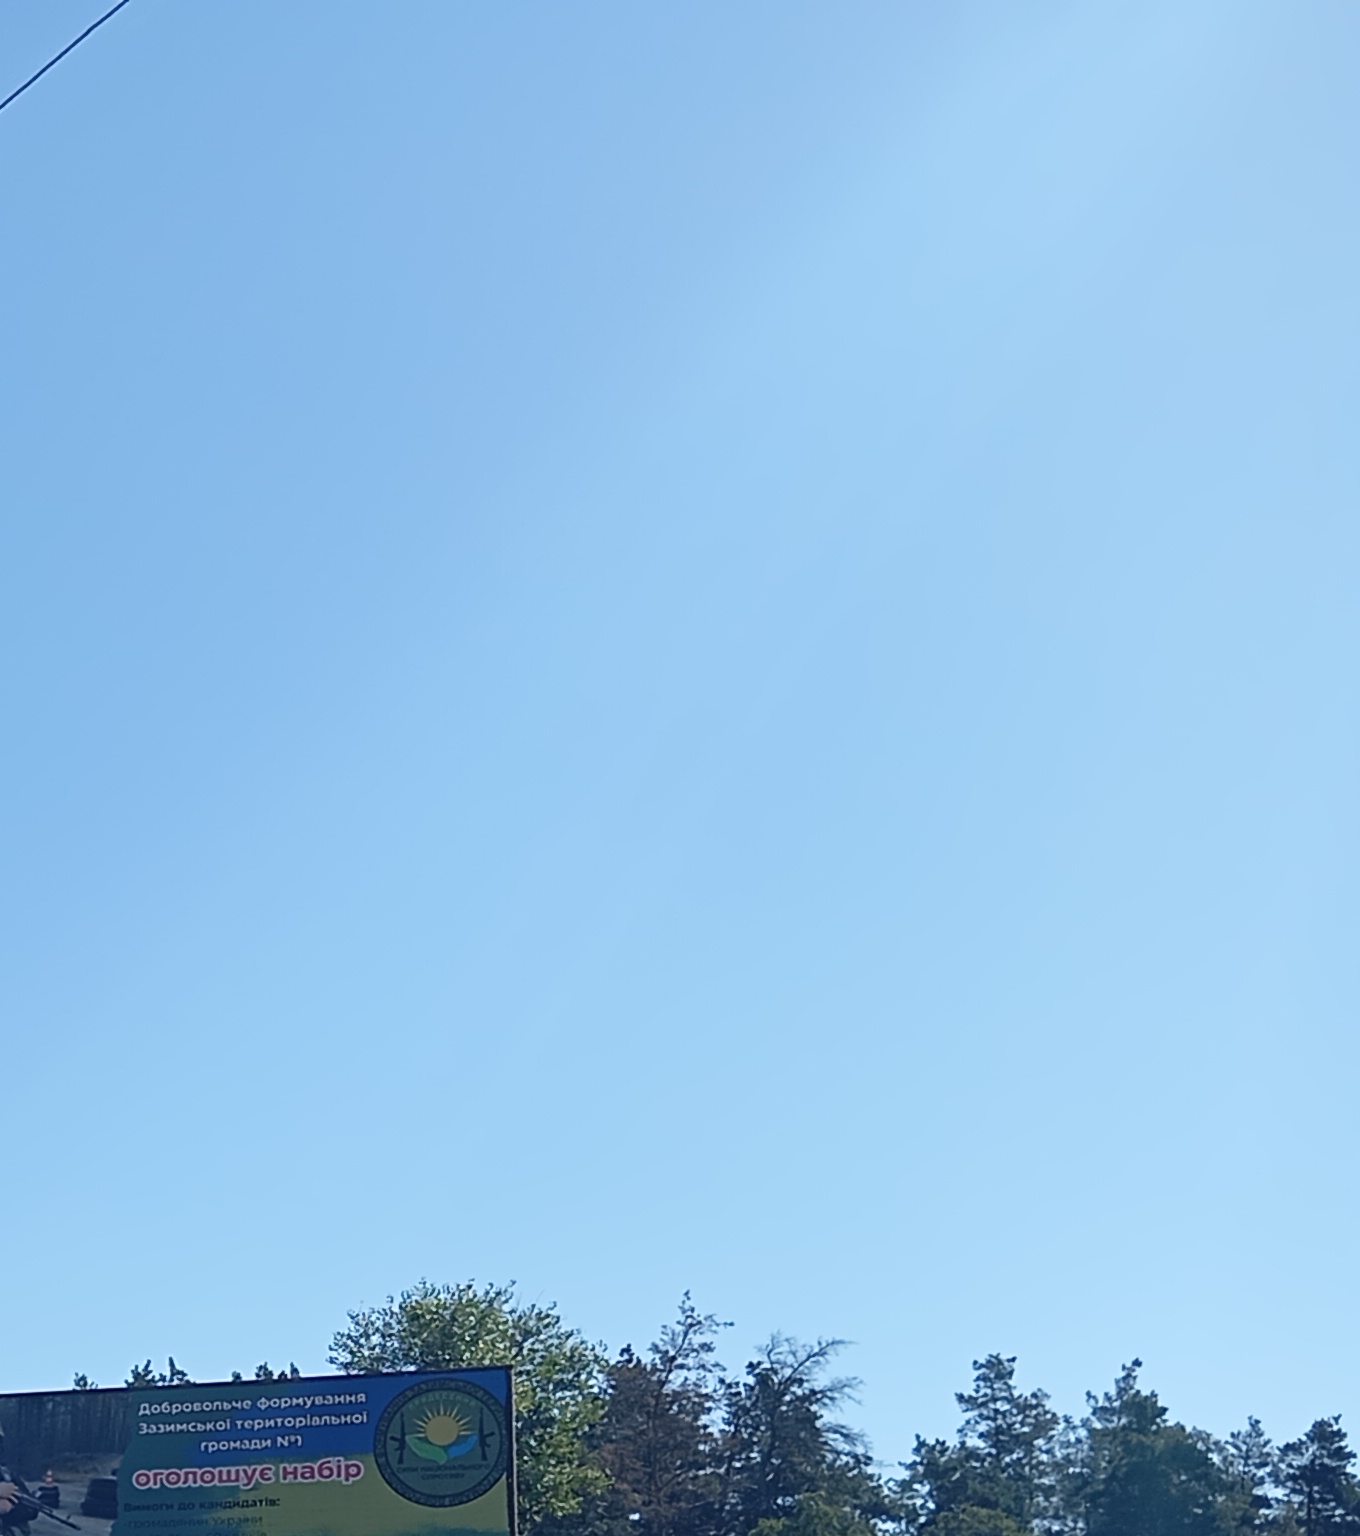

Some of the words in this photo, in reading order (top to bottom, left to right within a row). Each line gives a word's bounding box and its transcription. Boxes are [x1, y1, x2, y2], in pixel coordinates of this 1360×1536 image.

[138, 1399, 251, 1417] Добровольче
[256, 1392, 367, 1411] формування
[138, 1418, 231, 1435] Зазимської
[235, 1411, 368, 1432] територіальної
[200, 1438, 271, 1454] громади
[133, 1463, 275, 1489] оголошує
[280, 1457, 365, 1484] набір
[177, 1502, 195, 1511] до
[198, 1497, 281, 1510] кандидатів:
